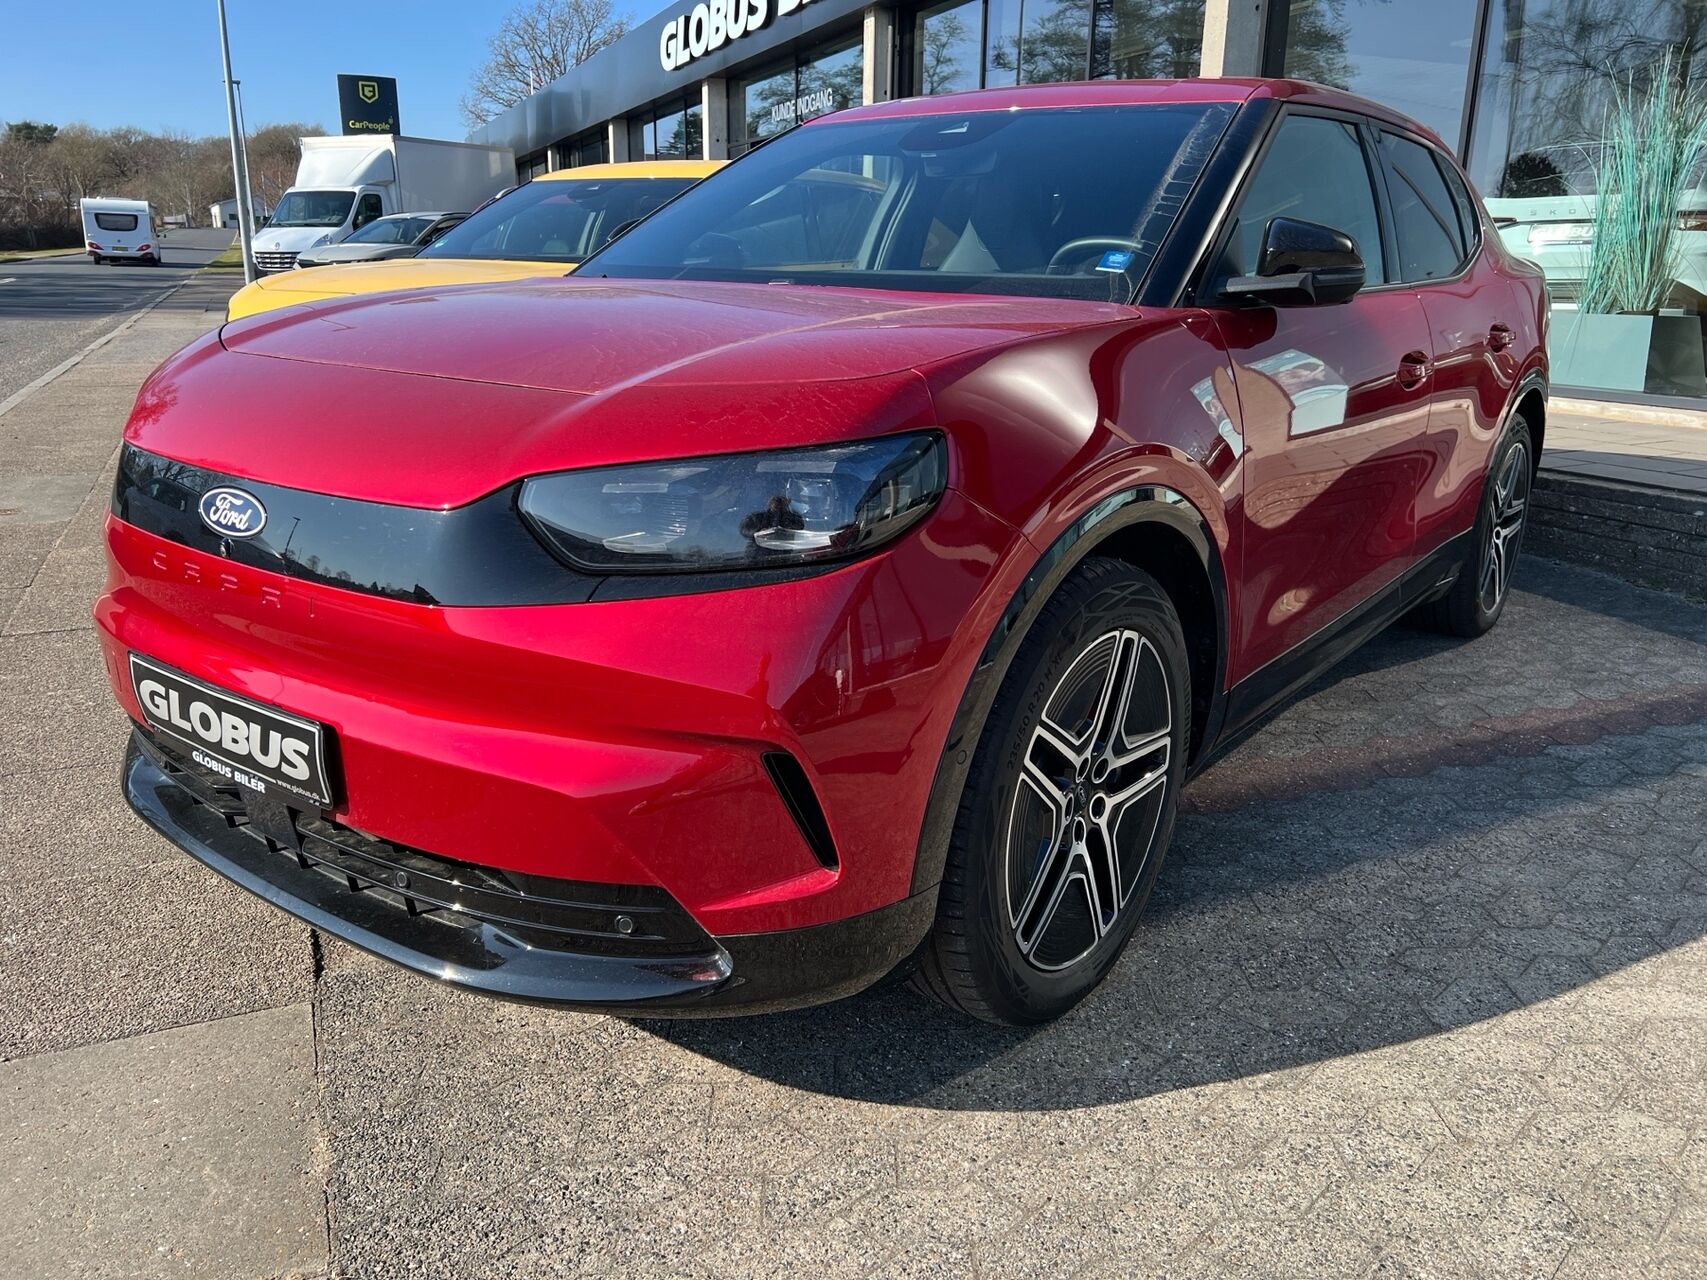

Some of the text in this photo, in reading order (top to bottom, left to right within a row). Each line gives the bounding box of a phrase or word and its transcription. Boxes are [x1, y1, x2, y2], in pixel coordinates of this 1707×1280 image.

[660, 0, 767, 71] GLOBUS
[771, 88, 833, 122] KUNDE INDGANG
[349, 120, 390, 131] CarPeople
[1529, 208, 1598, 216] SKOD
[210, 493, 252, 530] Ford
[153, 552, 315, 617] CAPRI
[1033, 681, 1046, 702] 20
[139, 679, 310, 781] GLOBUS
[192, 750, 266, 794] GLOBUS BILER
